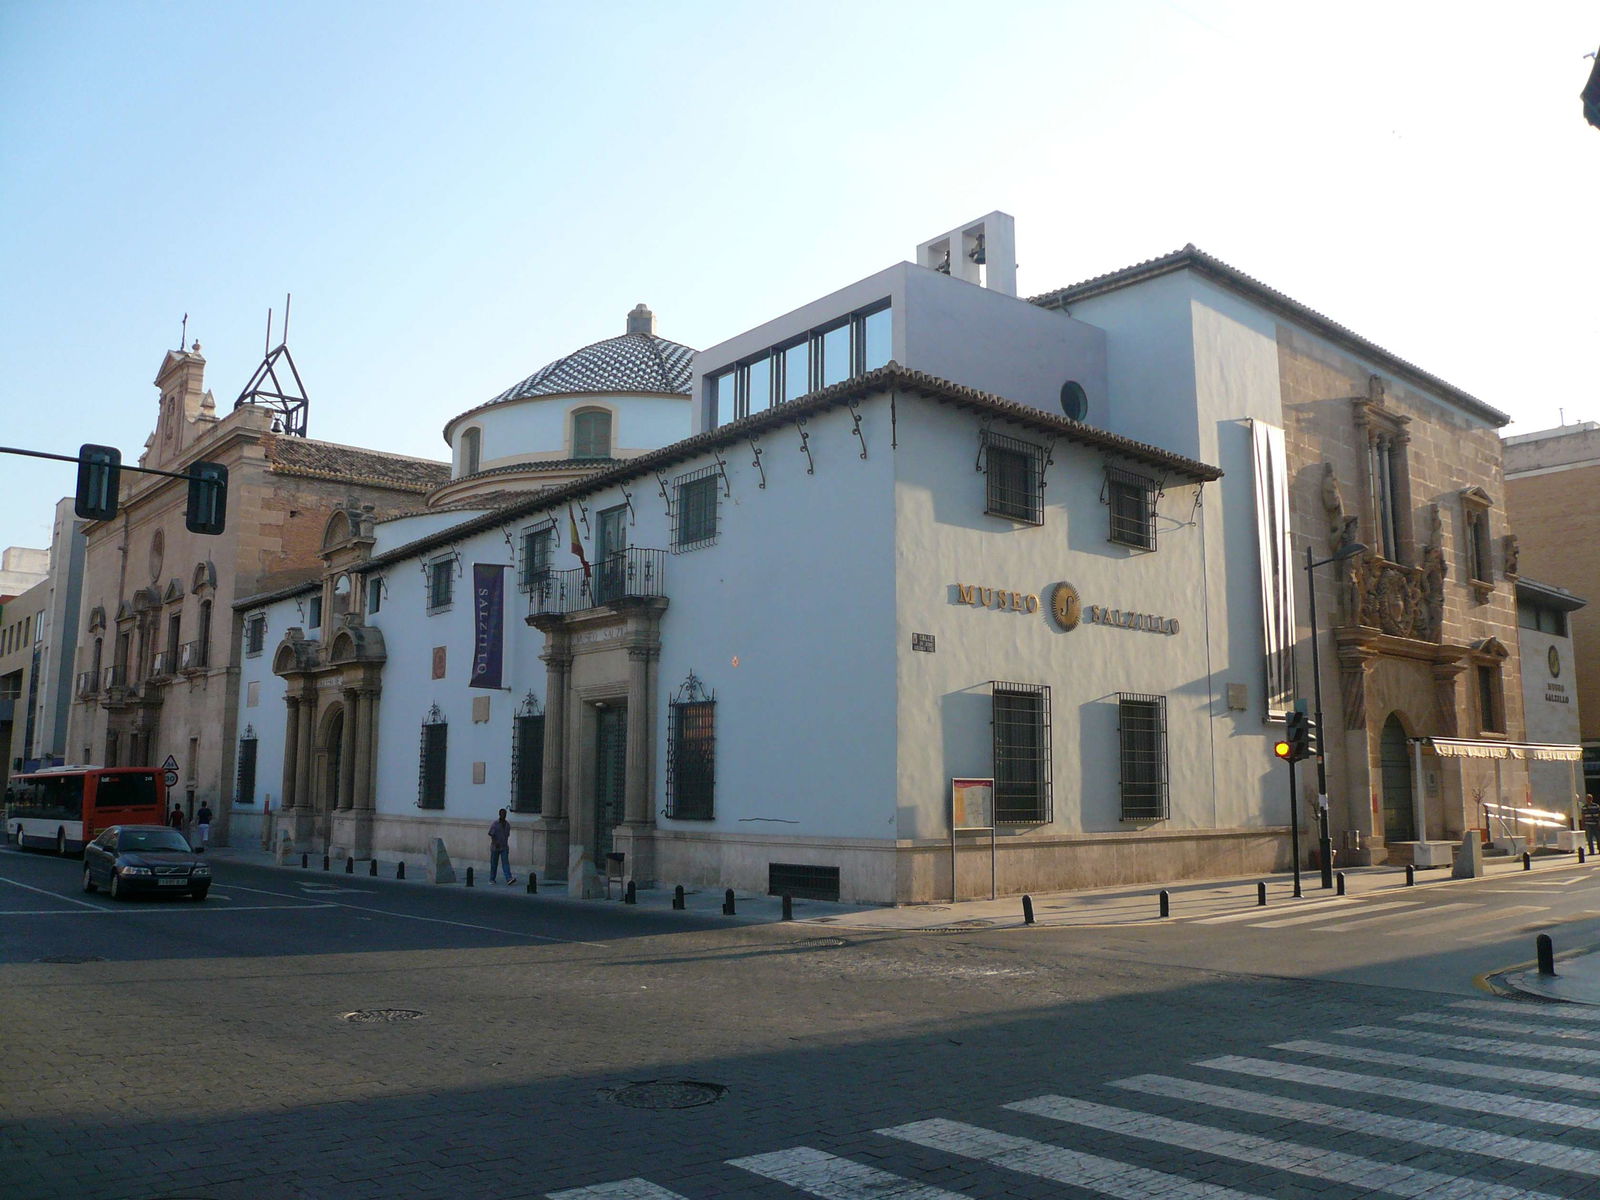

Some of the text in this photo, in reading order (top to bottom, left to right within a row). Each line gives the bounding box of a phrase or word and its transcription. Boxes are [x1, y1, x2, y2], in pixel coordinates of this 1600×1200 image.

[957, 583, 1040, 614] MUSEO
[477, 588, 489, 674] SALZILLO
[1091, 604, 1180, 635] SALZILLO
